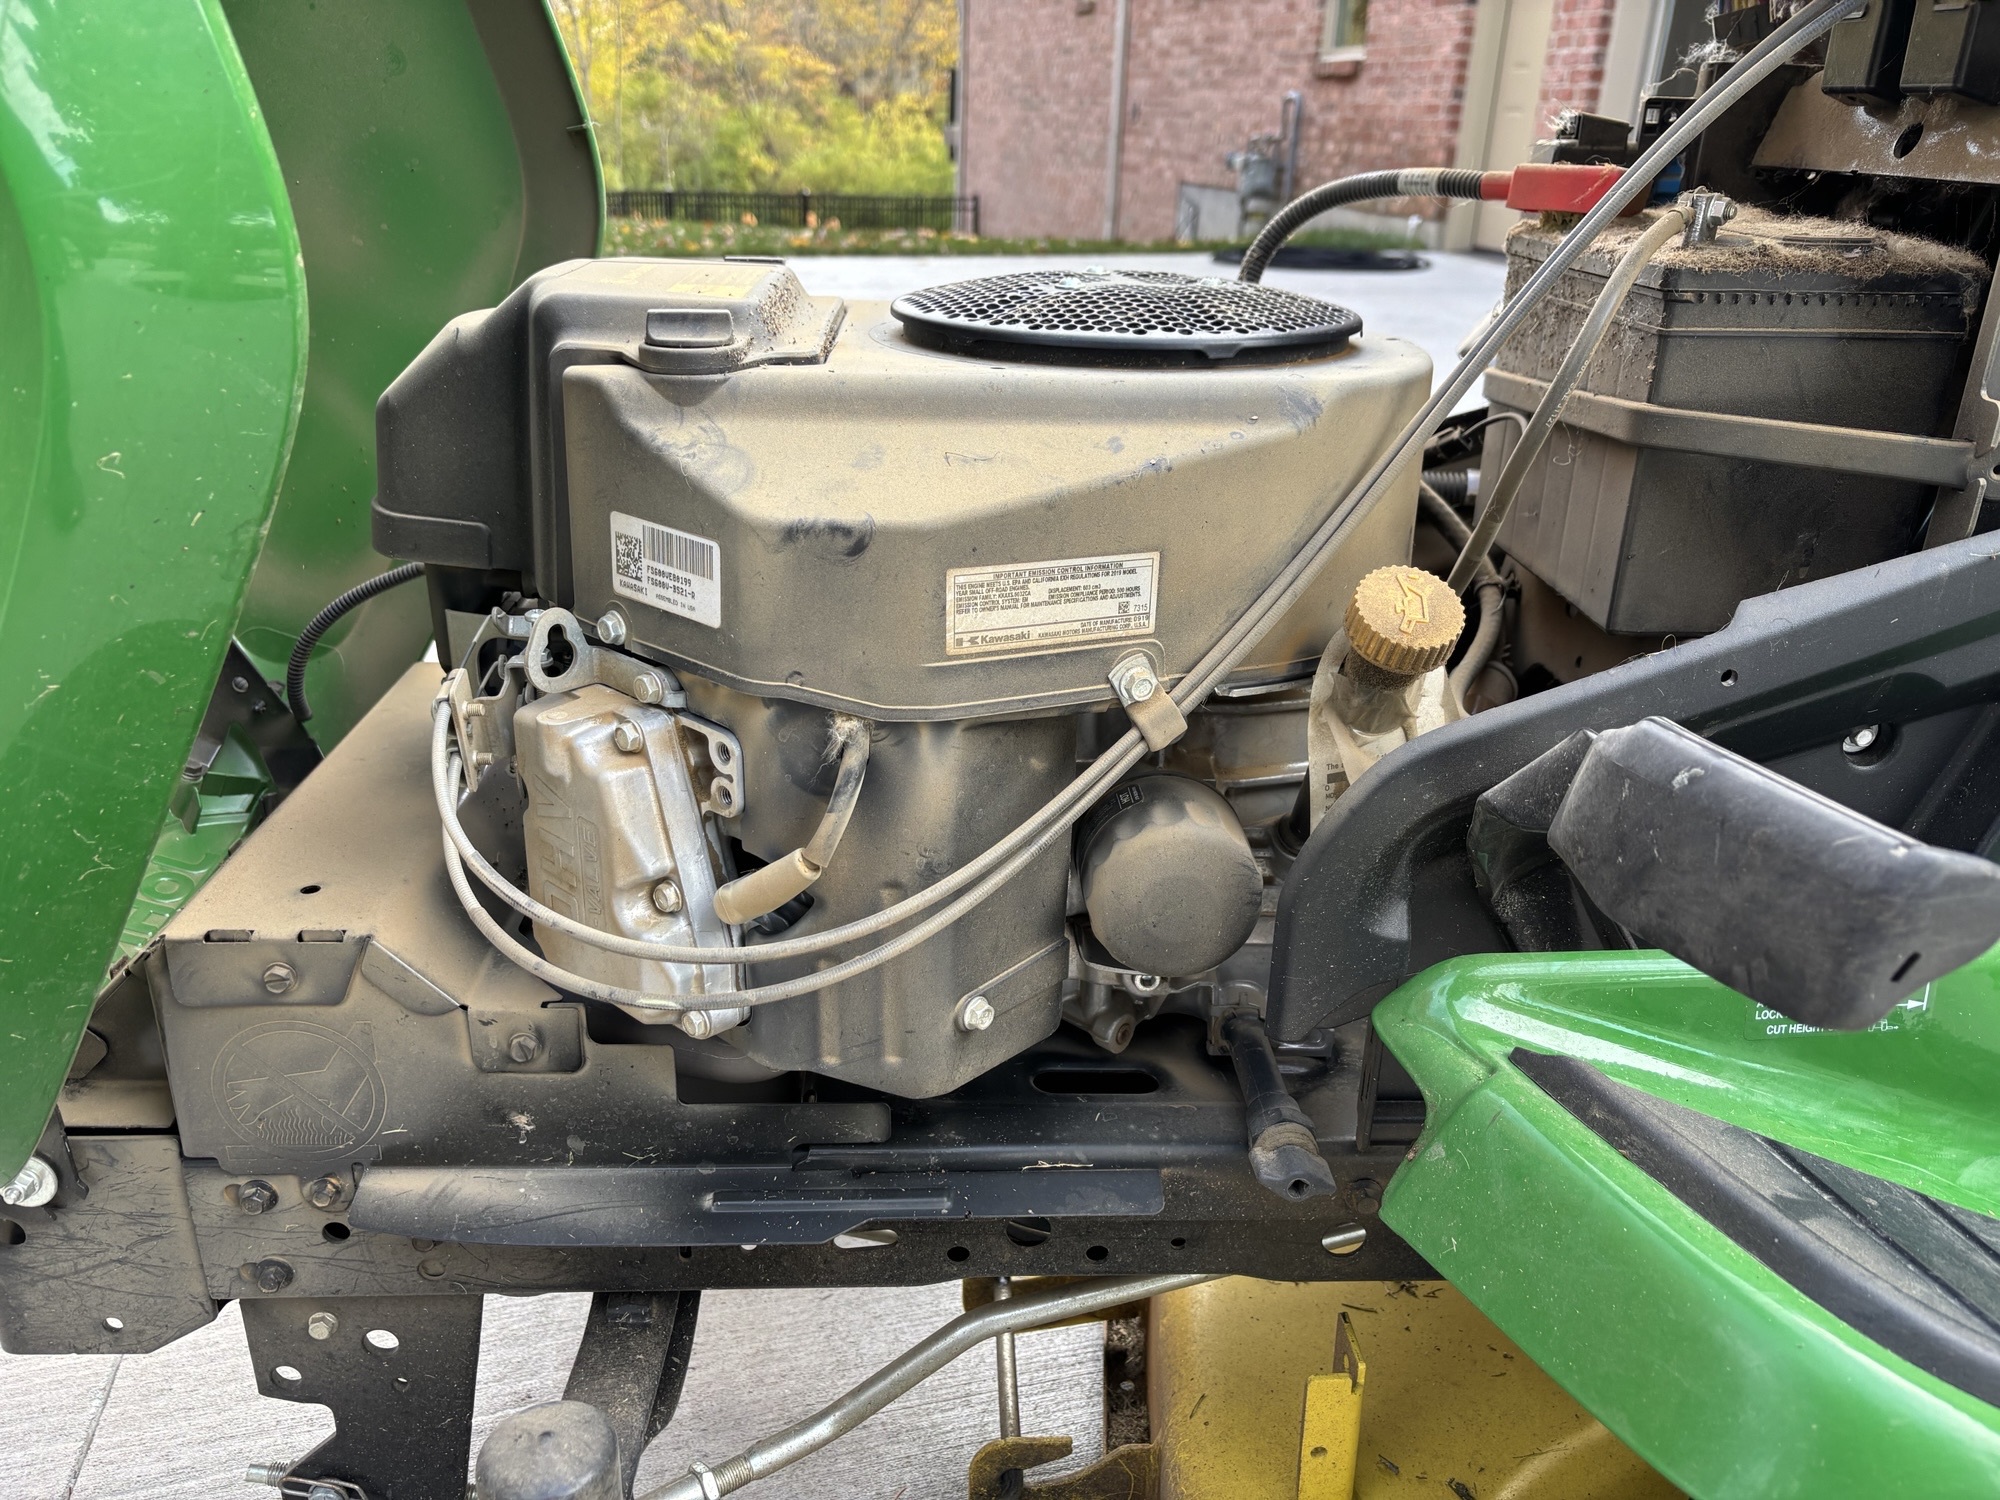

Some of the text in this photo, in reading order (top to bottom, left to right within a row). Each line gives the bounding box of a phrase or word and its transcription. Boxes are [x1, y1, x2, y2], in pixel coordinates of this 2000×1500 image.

[993, 563, 1123, 580] IMPORTANT EMISSION CONTROL INFORMATION
[1032, 576, 1059, 584] CALIFORNIA
[1070, 572, 1100, 580] REGULATIONS
[619, 579, 648, 596] KAWASAKI
[646, 576, 695, 600] FS600V-BS21-R
[985, 586, 1008, 594] OFF-ROAD
[1048, 586, 1082, 594] DISPLACEMENT:
[1070, 590, 1098, 598] COMPLIANCE
[655, 594, 679, 606] ASSEMBLED
[688, 604, 696, 612] USA
[1031, 598, 1062, 607] MAINTENANCE
[1063, 596, 1099, 604] SPECIFICATIONS
[1109, 591, 1142, 600] ADJUSTMENTS.
[1133, 604, 1148, 612] 7315
[1100, 617, 1132, 626] MANUFACTURE:
[980, 630, 1030, 644] Kawasaki
[1038, 630, 1061, 639] KAWASAKI
[1062, 628, 1081, 636] MOTORS
[1081, 624, 1119, 633] MANUFACTURING
[1766, 1025, 1787, 1035] CUT
